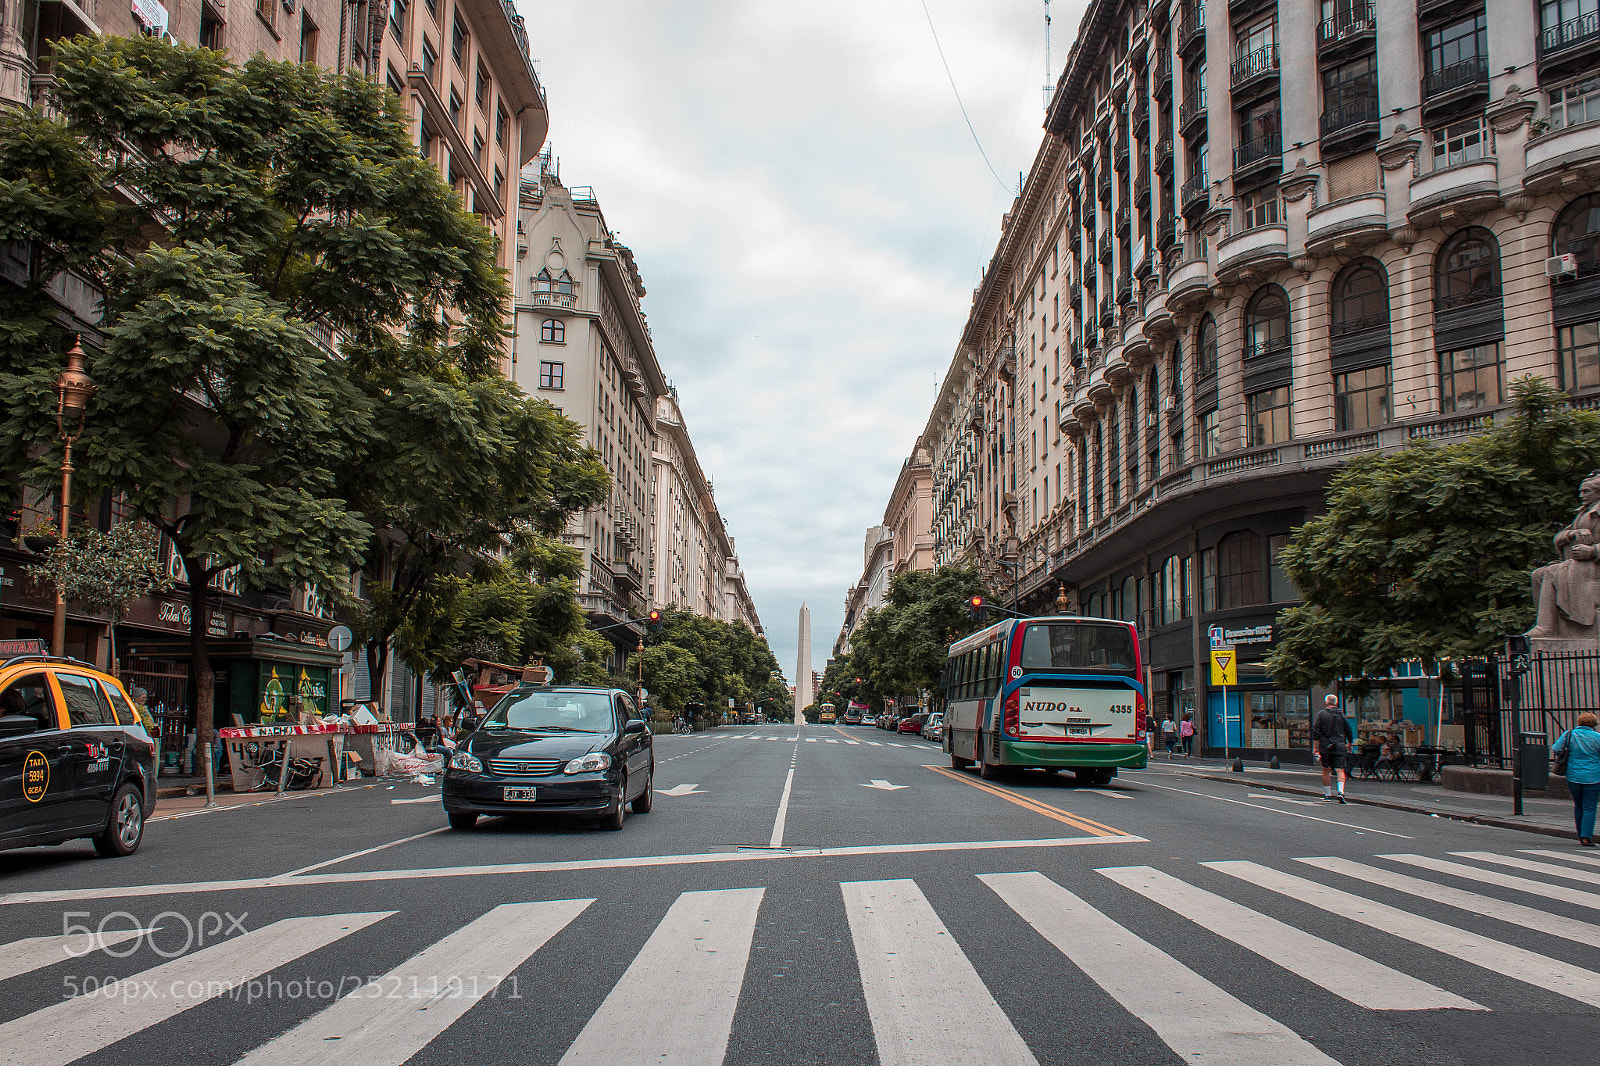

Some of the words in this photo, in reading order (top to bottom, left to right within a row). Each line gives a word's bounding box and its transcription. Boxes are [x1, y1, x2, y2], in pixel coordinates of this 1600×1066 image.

[1012, 668, 1021, 677] 60
[1023, 701, 1067, 712] NUDO
[1109, 704, 1132, 714] 4355
[29, 758, 44, 767] TAXI
[27, 786, 43, 795] GCBA
